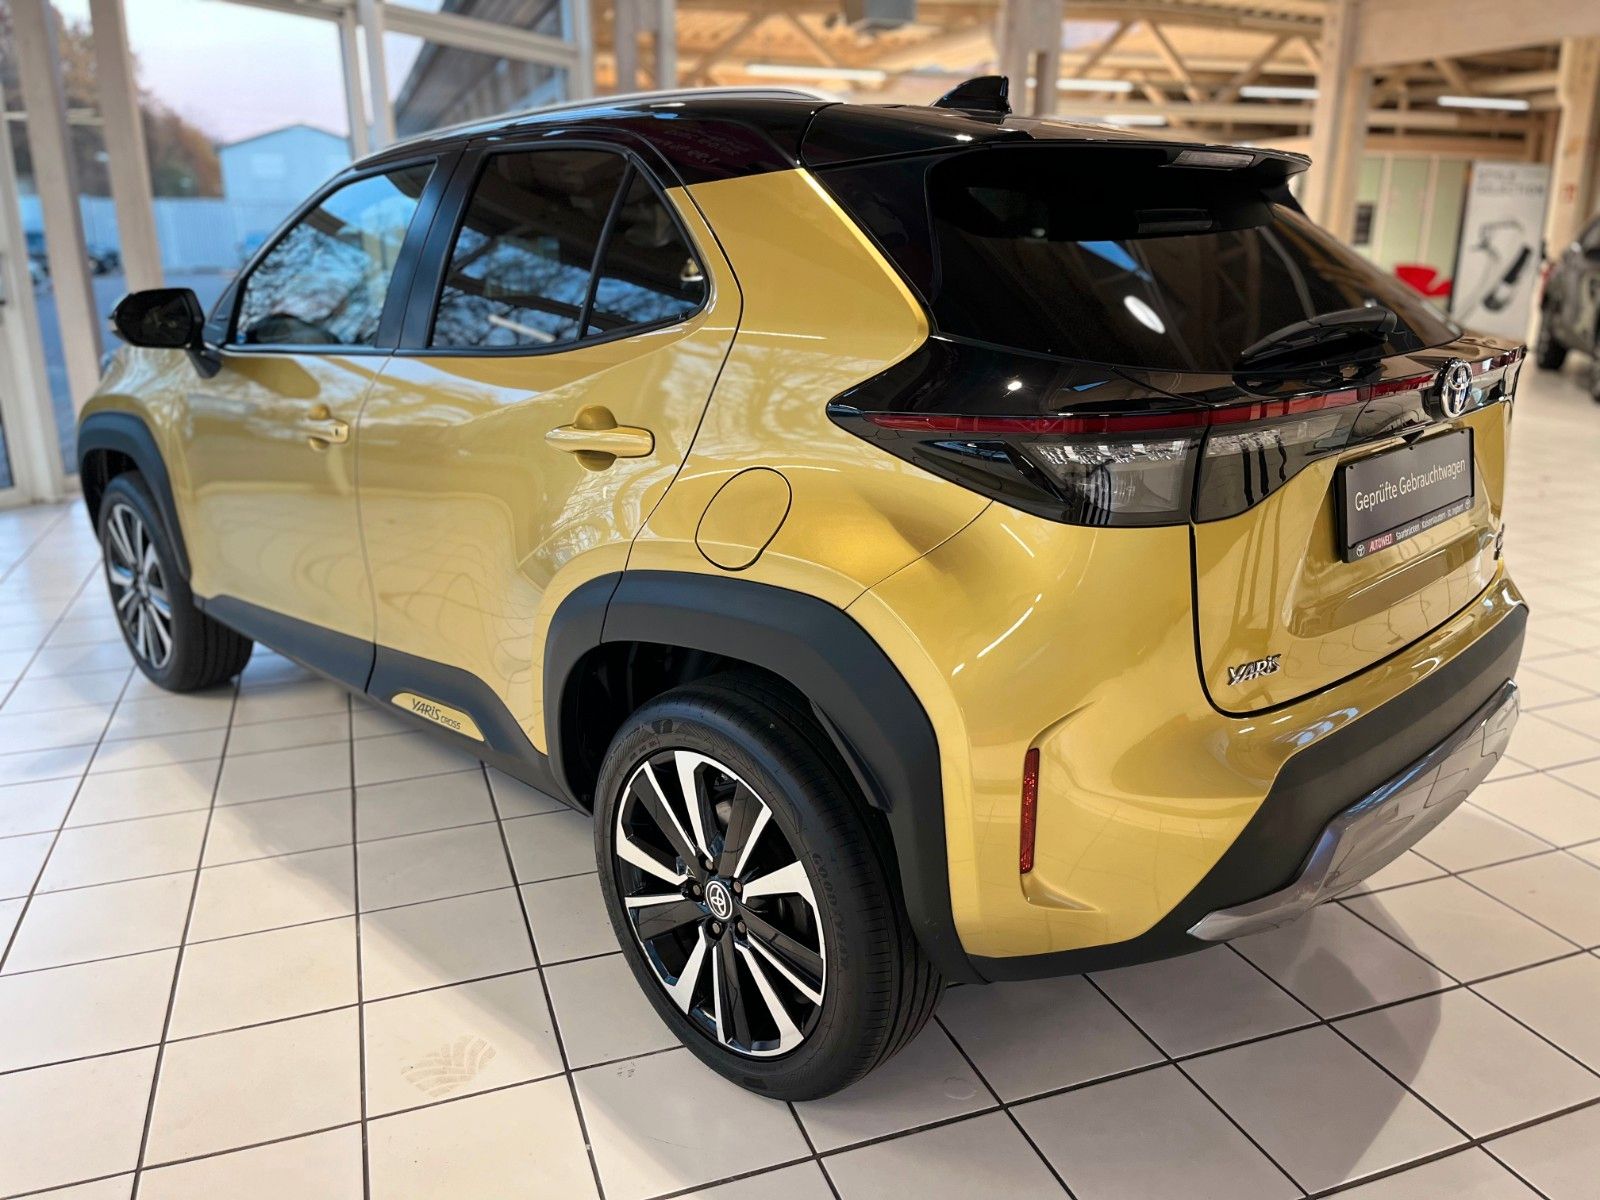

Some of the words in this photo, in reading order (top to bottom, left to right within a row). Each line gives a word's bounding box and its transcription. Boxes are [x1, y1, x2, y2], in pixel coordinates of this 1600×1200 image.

[1355, 480, 1398, 512] Geprüfte
[1399, 458, 1466, 495] Gebrauchtwagen
[1227, 653, 1281, 686] YARIS
[411, 697, 442, 721] YARIS
[440, 714, 461, 730] CROSS
